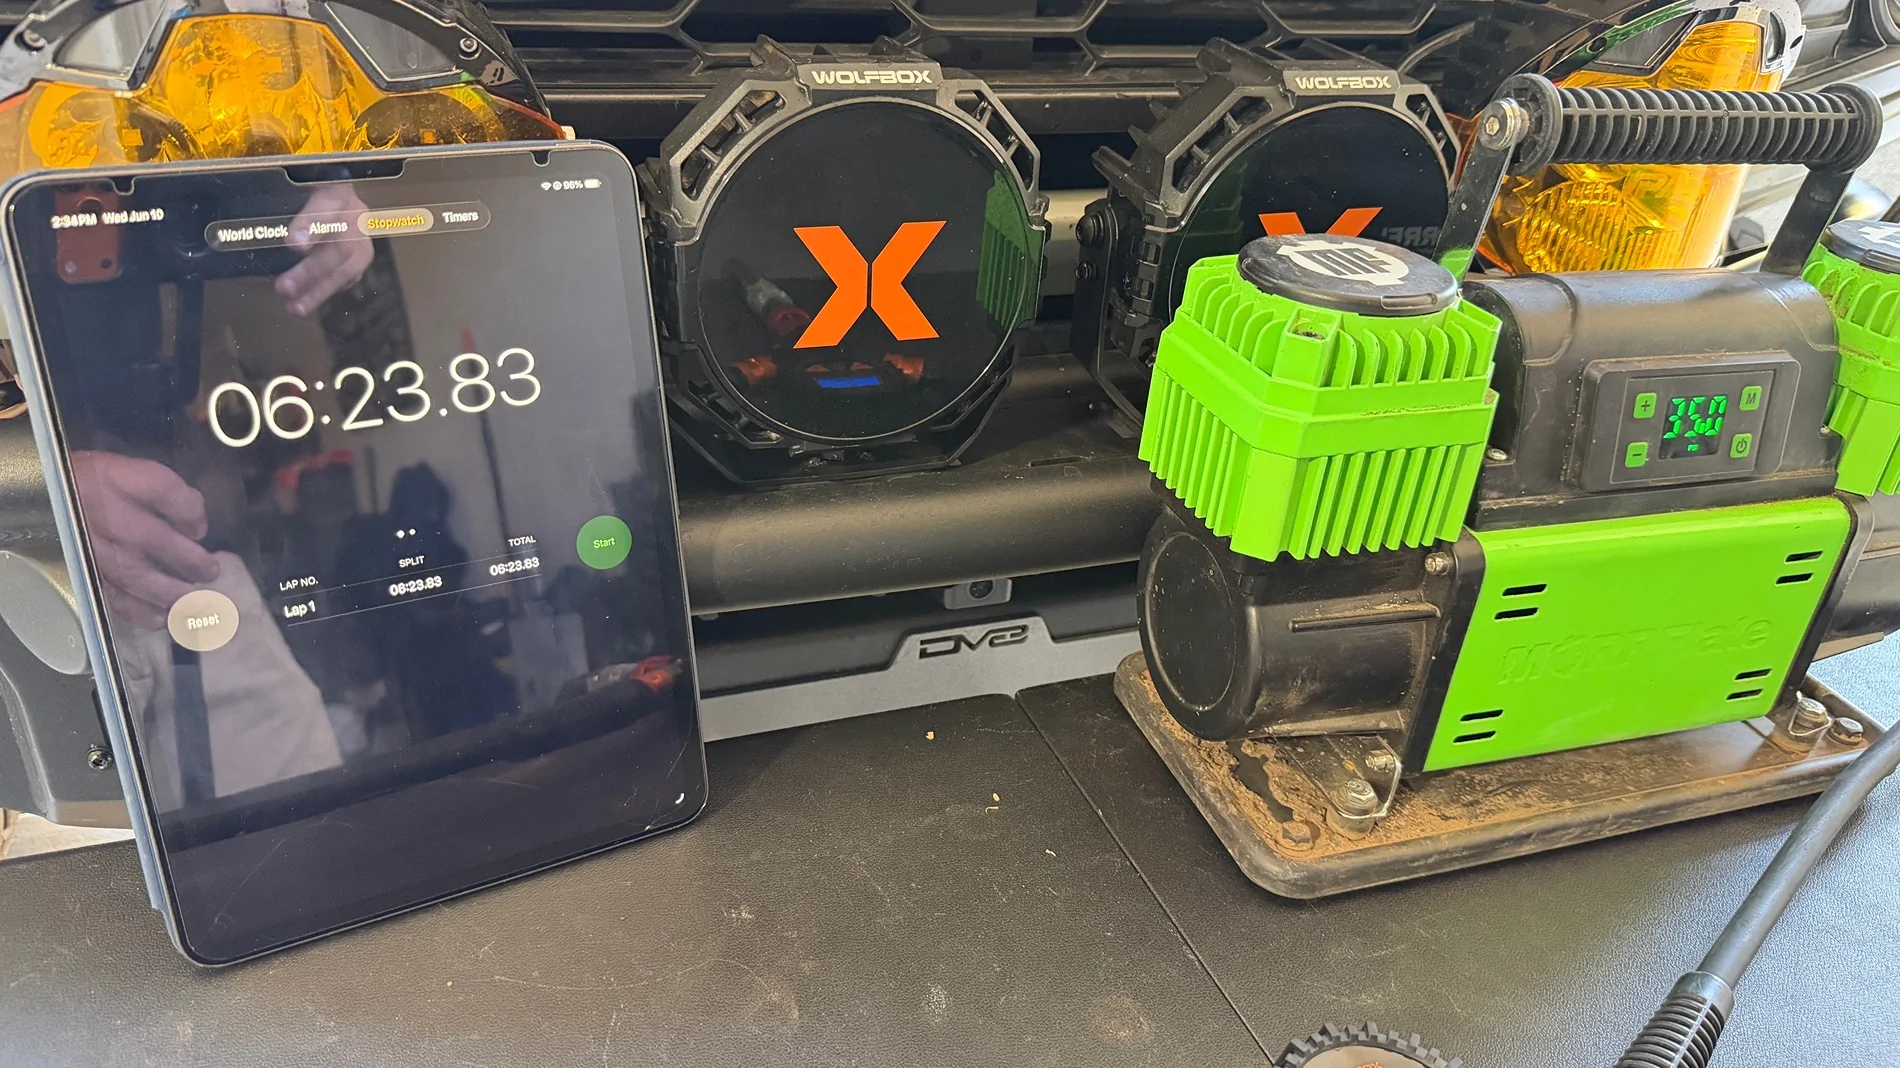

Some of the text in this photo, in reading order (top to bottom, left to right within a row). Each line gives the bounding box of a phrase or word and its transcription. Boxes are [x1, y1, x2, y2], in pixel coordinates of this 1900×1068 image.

[811, 70, 933, 85] WOLFBOX
[1295, 76, 1392, 90] WOLFBOX
[563, 180, 584, 190] 96%
[102, 210, 128, 225] Wed
[129, 209, 150, 222] Jun
[150, 207, 165, 221] 10
[367, 214, 425, 230] Stopwatch
[442, 211, 479, 224] Timers
[218, 224, 289, 243] World Clock
[309, 221, 348, 235] Alarms
[207, 347, 542, 448] 06:23.83
[1745, 392, 1757, 405] M
[508, 535, 536, 547] TOTAL
[593, 536, 615, 549] Start
[399, 555, 425, 568] SPLIT
[489, 557, 540, 576] 06:23.83
[279, 576, 318, 592] LAP NO.
[388, 575, 443, 597] 06:23.83
[284, 600, 316, 619] Lap 1
[187, 612, 220, 630] Reset
